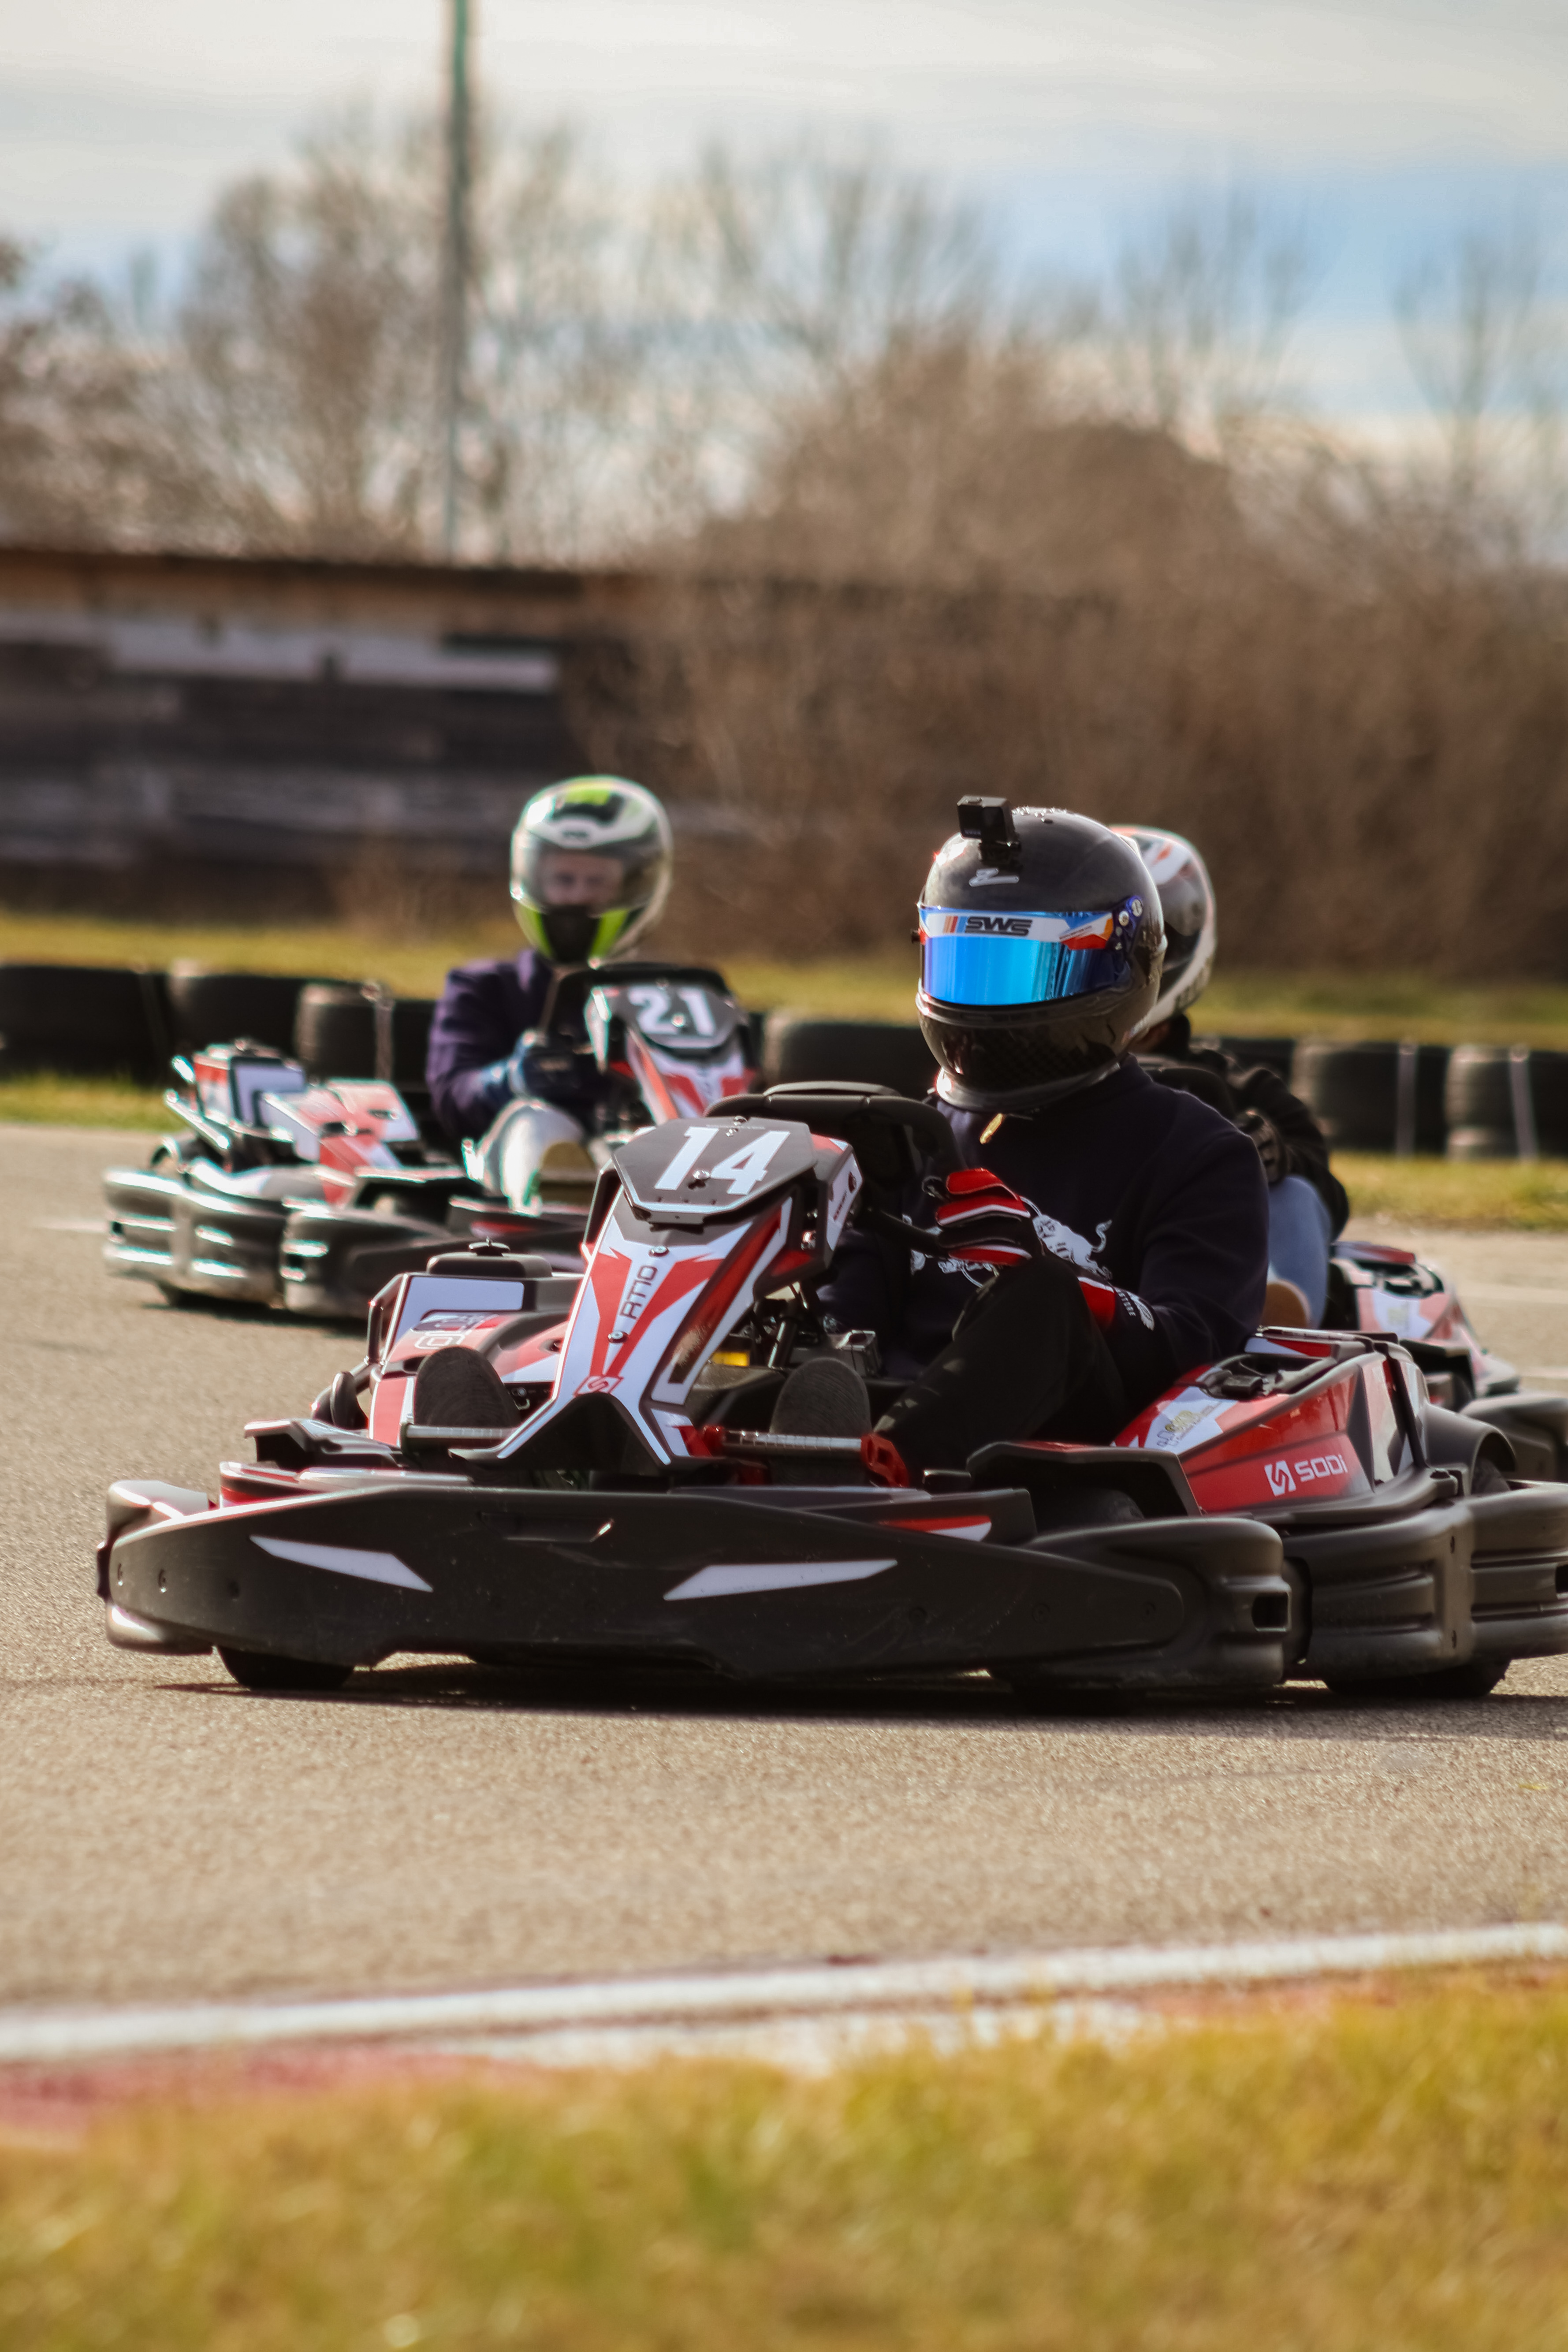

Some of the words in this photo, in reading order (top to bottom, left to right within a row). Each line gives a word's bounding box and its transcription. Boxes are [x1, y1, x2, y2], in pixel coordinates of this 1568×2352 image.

[965, 916, 1033, 936] SWS
[628, 985, 715, 1036] 21
[655, 1126, 790, 1196] 14
